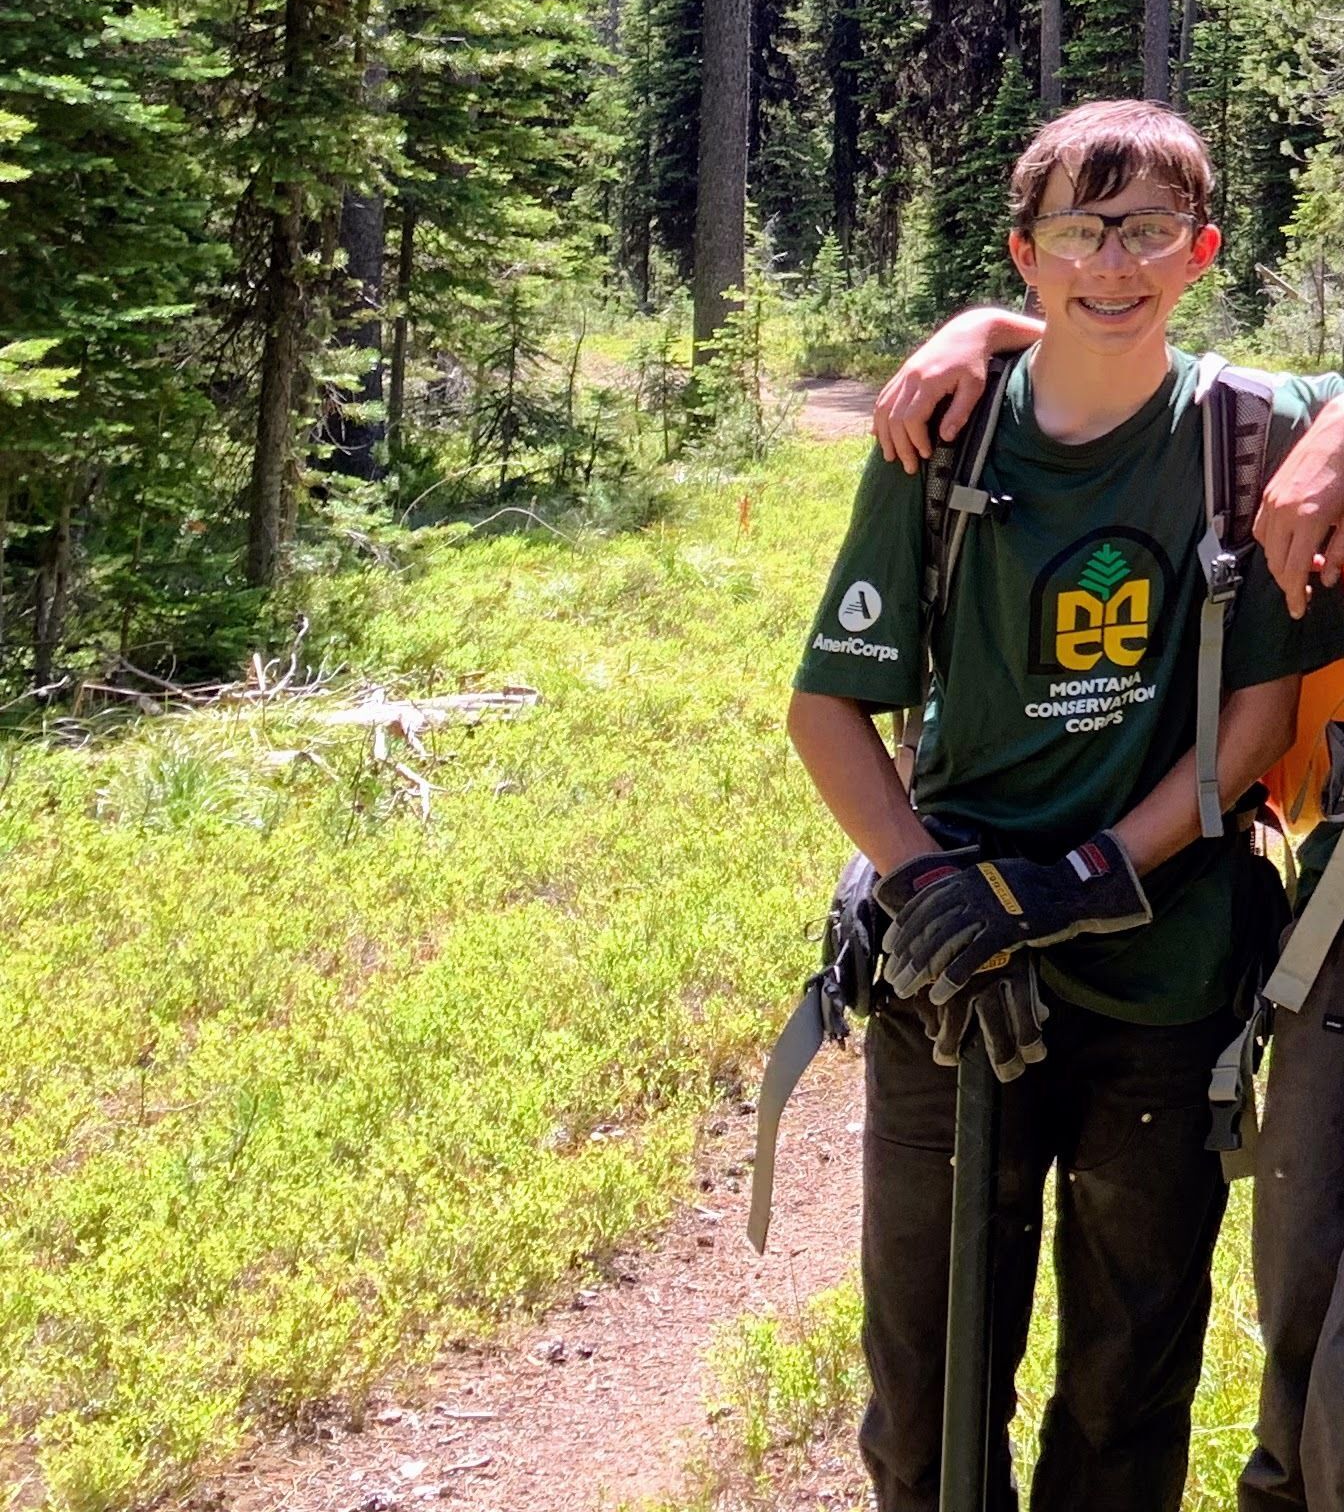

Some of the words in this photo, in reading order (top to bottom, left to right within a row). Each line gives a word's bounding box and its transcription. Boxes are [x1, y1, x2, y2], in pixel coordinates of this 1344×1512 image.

[812, 632, 899, 663] AmeriCorps
[1049, 671, 1141, 698] MONTANA
[1025, 684, 1157, 718] CONSERVATION
[1065, 710, 1124, 734] CORPS
